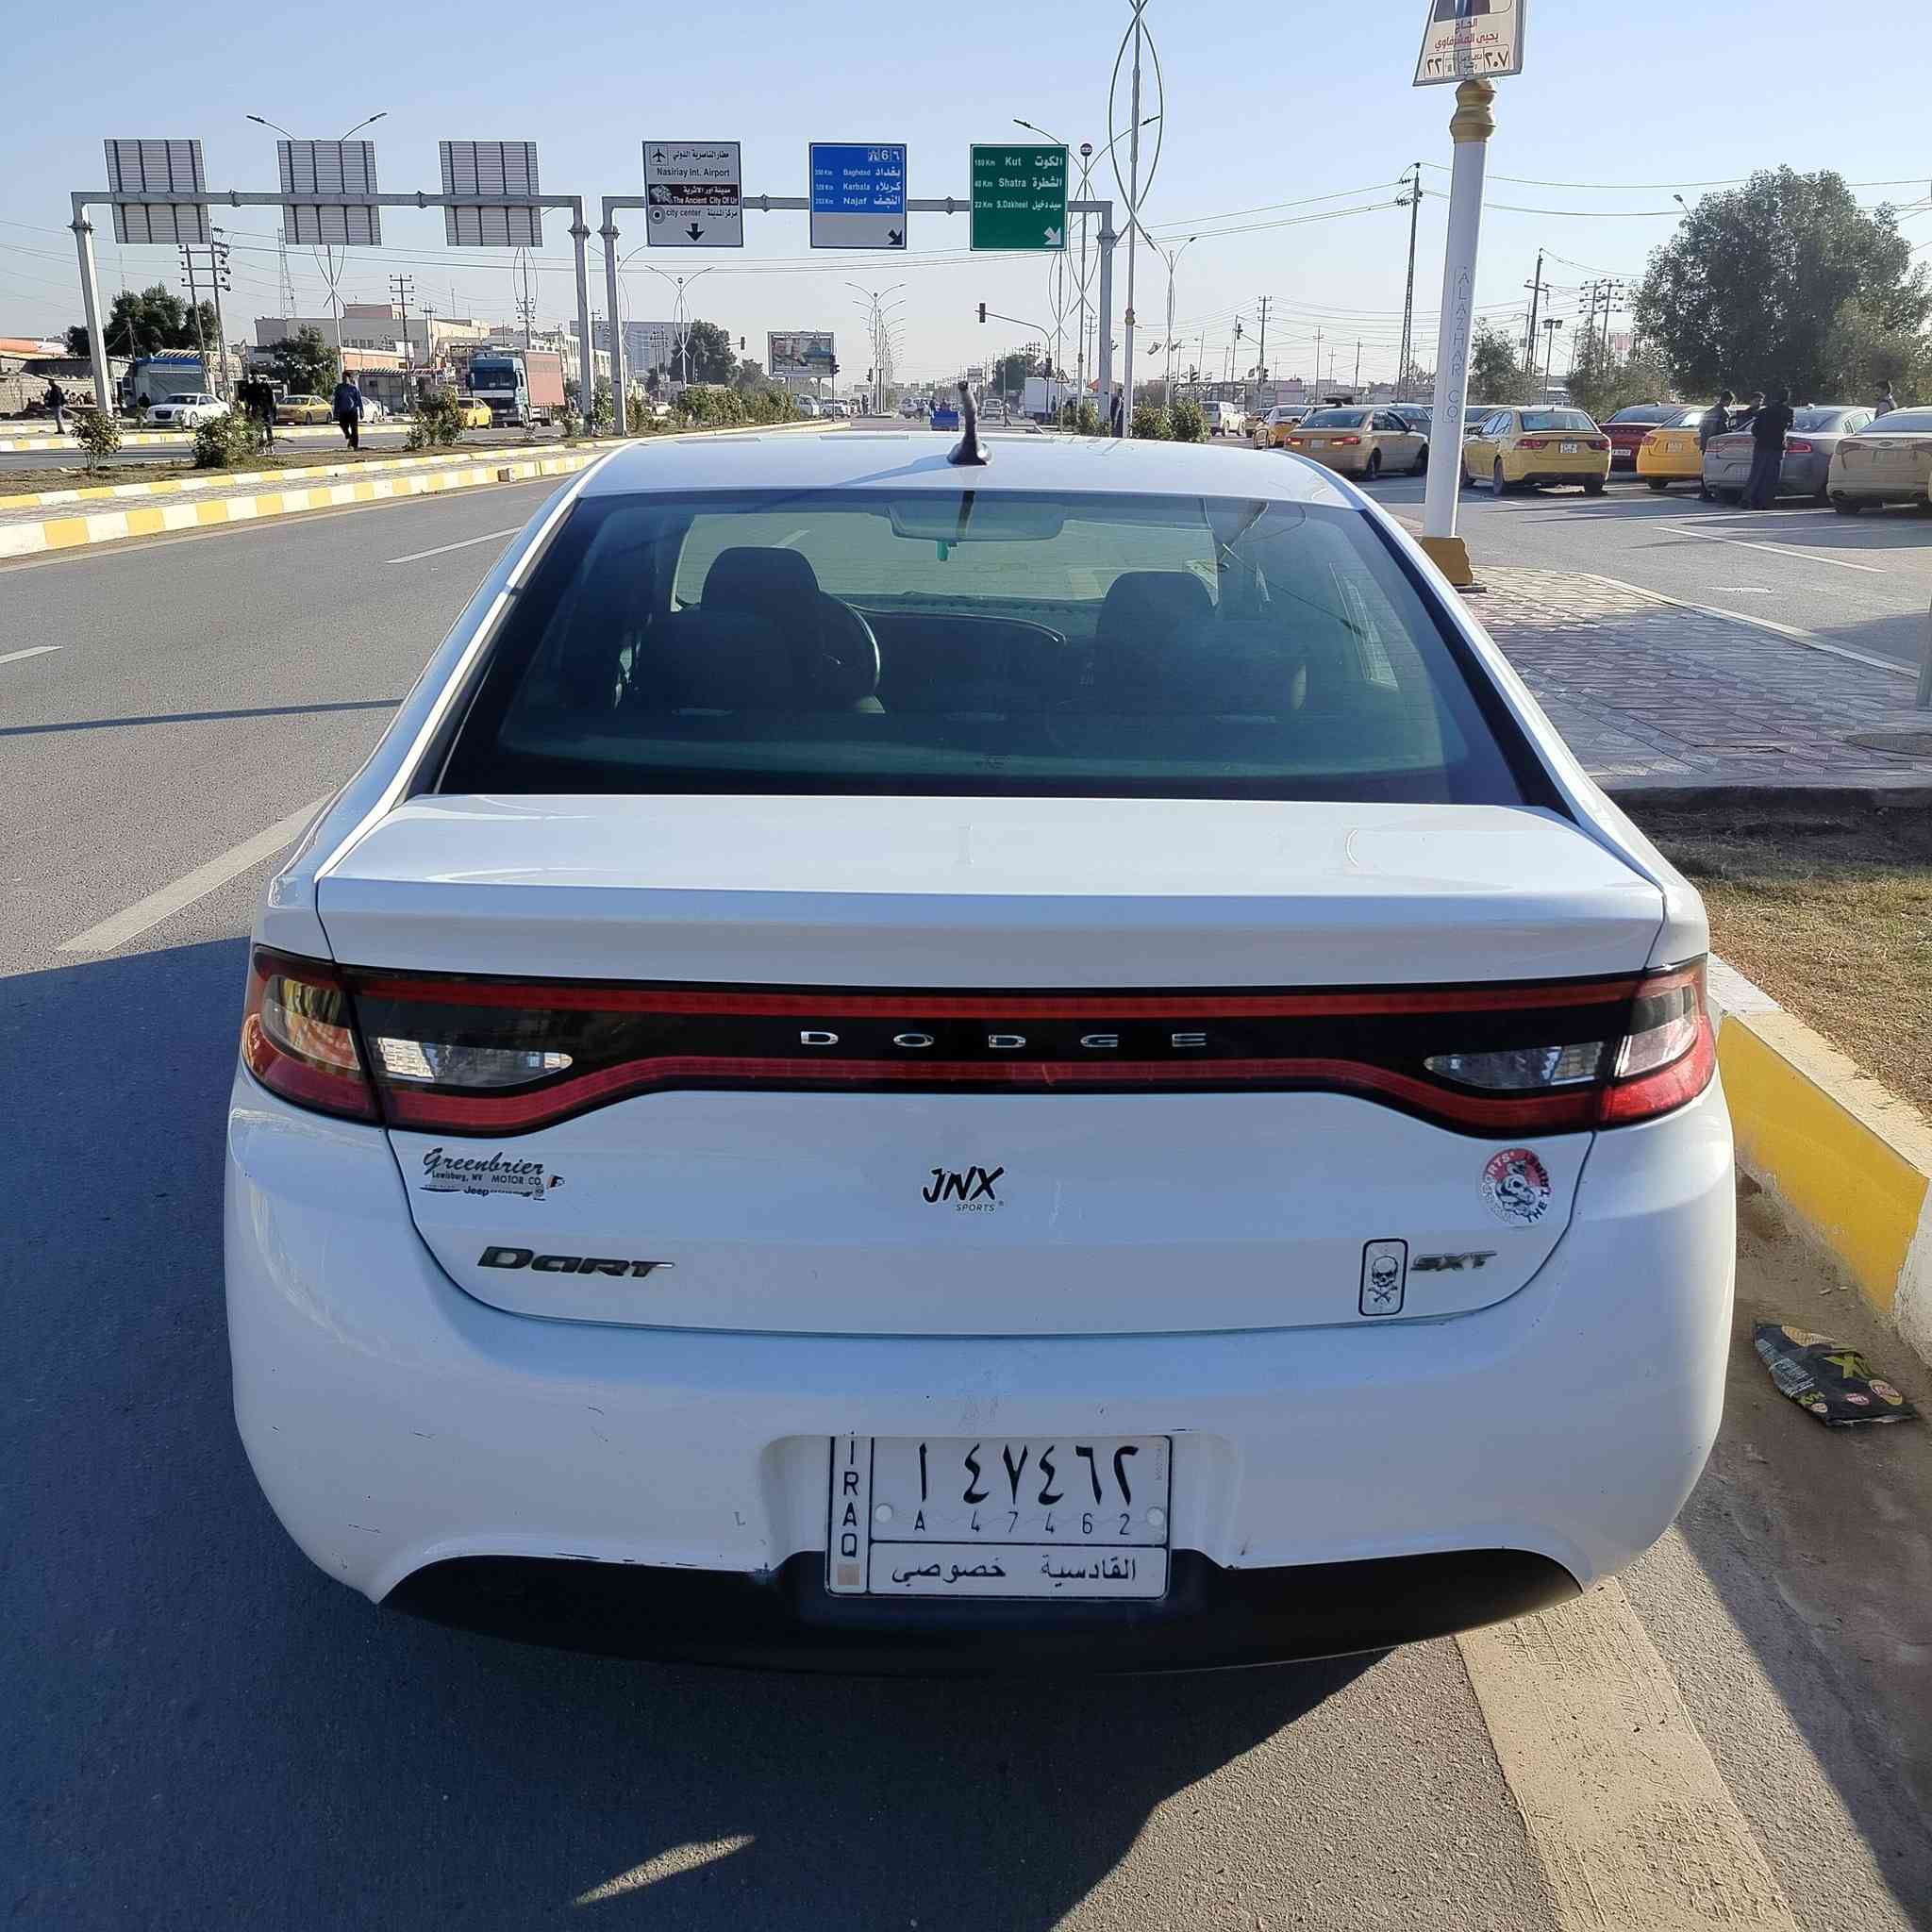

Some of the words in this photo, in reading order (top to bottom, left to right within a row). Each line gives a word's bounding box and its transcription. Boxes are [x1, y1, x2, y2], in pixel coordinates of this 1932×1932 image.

[881, 150, 889, 160] 6
[1005, 157, 1022, 166] Kut
[1035, 155, 1063, 169] الكوت
[704, 168, 730, 178] Airport
[998, 177, 1026, 188] Shatra
[1032, 175, 1063, 190] الشطرة
[685, 196, 708, 205] Ancient
[709, 196, 722, 206] City
[843, 197, 867, 207] Najaf
[1451, 272, 1470, 377] ALAZHAR
[800, 1030, 1208, 1049] DODGE
[423, 1147, 544, 1175] Greenbrier
[491, 1174, 524, 1185] MOTOR
[922, 1165, 1005, 1203] JNX
[463, 1185, 490, 1197] Jeep
[956, 1203, 995, 1212] SPORTS
[841, 1434, 859, 1557] IRAQ
[891, 1557, 1007, 1587] خصوصي
[1041, 1554, 1137, 1588] القادسية
